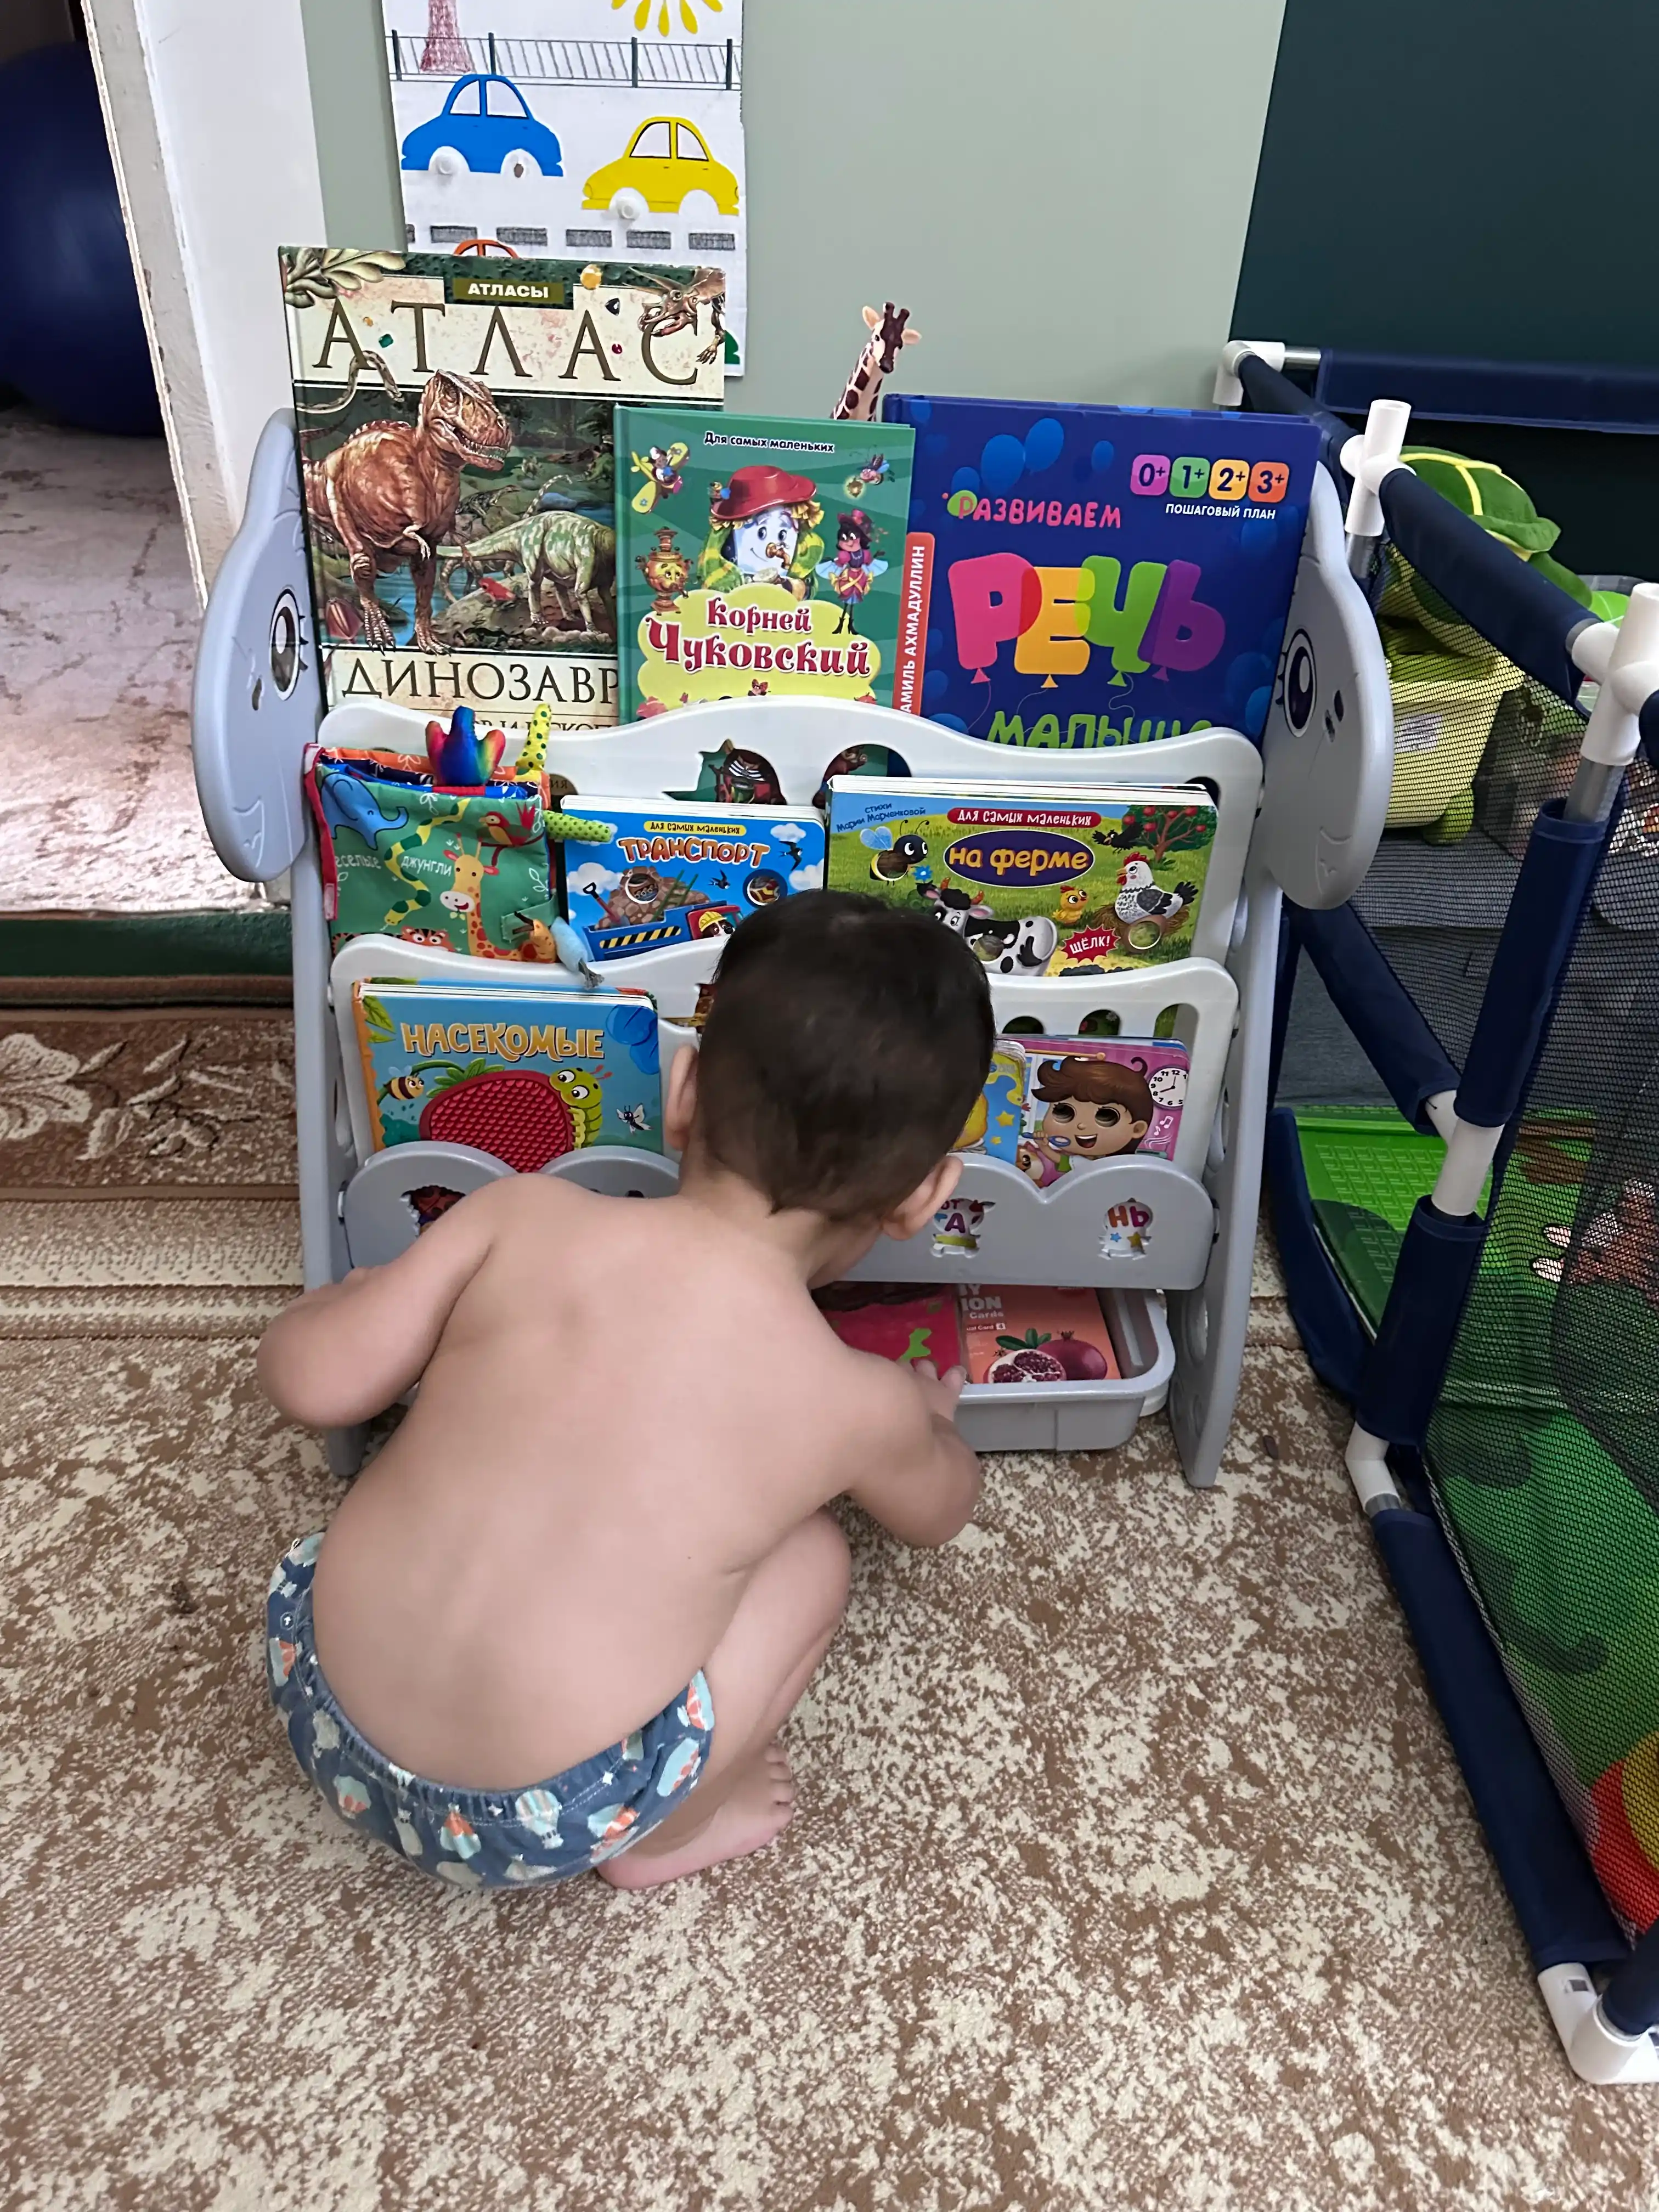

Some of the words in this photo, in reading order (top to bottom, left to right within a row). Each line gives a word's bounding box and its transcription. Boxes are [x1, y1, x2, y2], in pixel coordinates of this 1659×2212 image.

[467, 283, 549, 298] АТЛАСЫ
[313, 297, 701, 385] АТЛАС
[704, 431, 727, 445] Для
[730, 436, 768, 447] самых
[769, 439, 834, 452] маленьких
[1139, 462, 1166, 487] 0+
[1182, 465, 1205, 489] 1+
[1217, 467, 1246, 492] 2+
[1257, 470, 1285, 494] 3+
[958, 496, 1121, 528] РАЗВИВАЕМ
[1165, 503, 1240, 518] ПОШАГОВЫЙ
[1243, 508, 1276, 520] ПЛАН
[707, 597, 812, 634] Корней
[904, 546, 926, 657] АХМАДУЛЛИН
[947, 552, 1226, 676] РЕЧЬ
[645, 617, 871, 676] Чуковский
[618, 837, 770, 867] ТРАНСПОРТ
[1069, 935, 1110, 954] ЩЁЛК!
[400, 1022, 605, 1062] НАСЕКОМЫЕ
